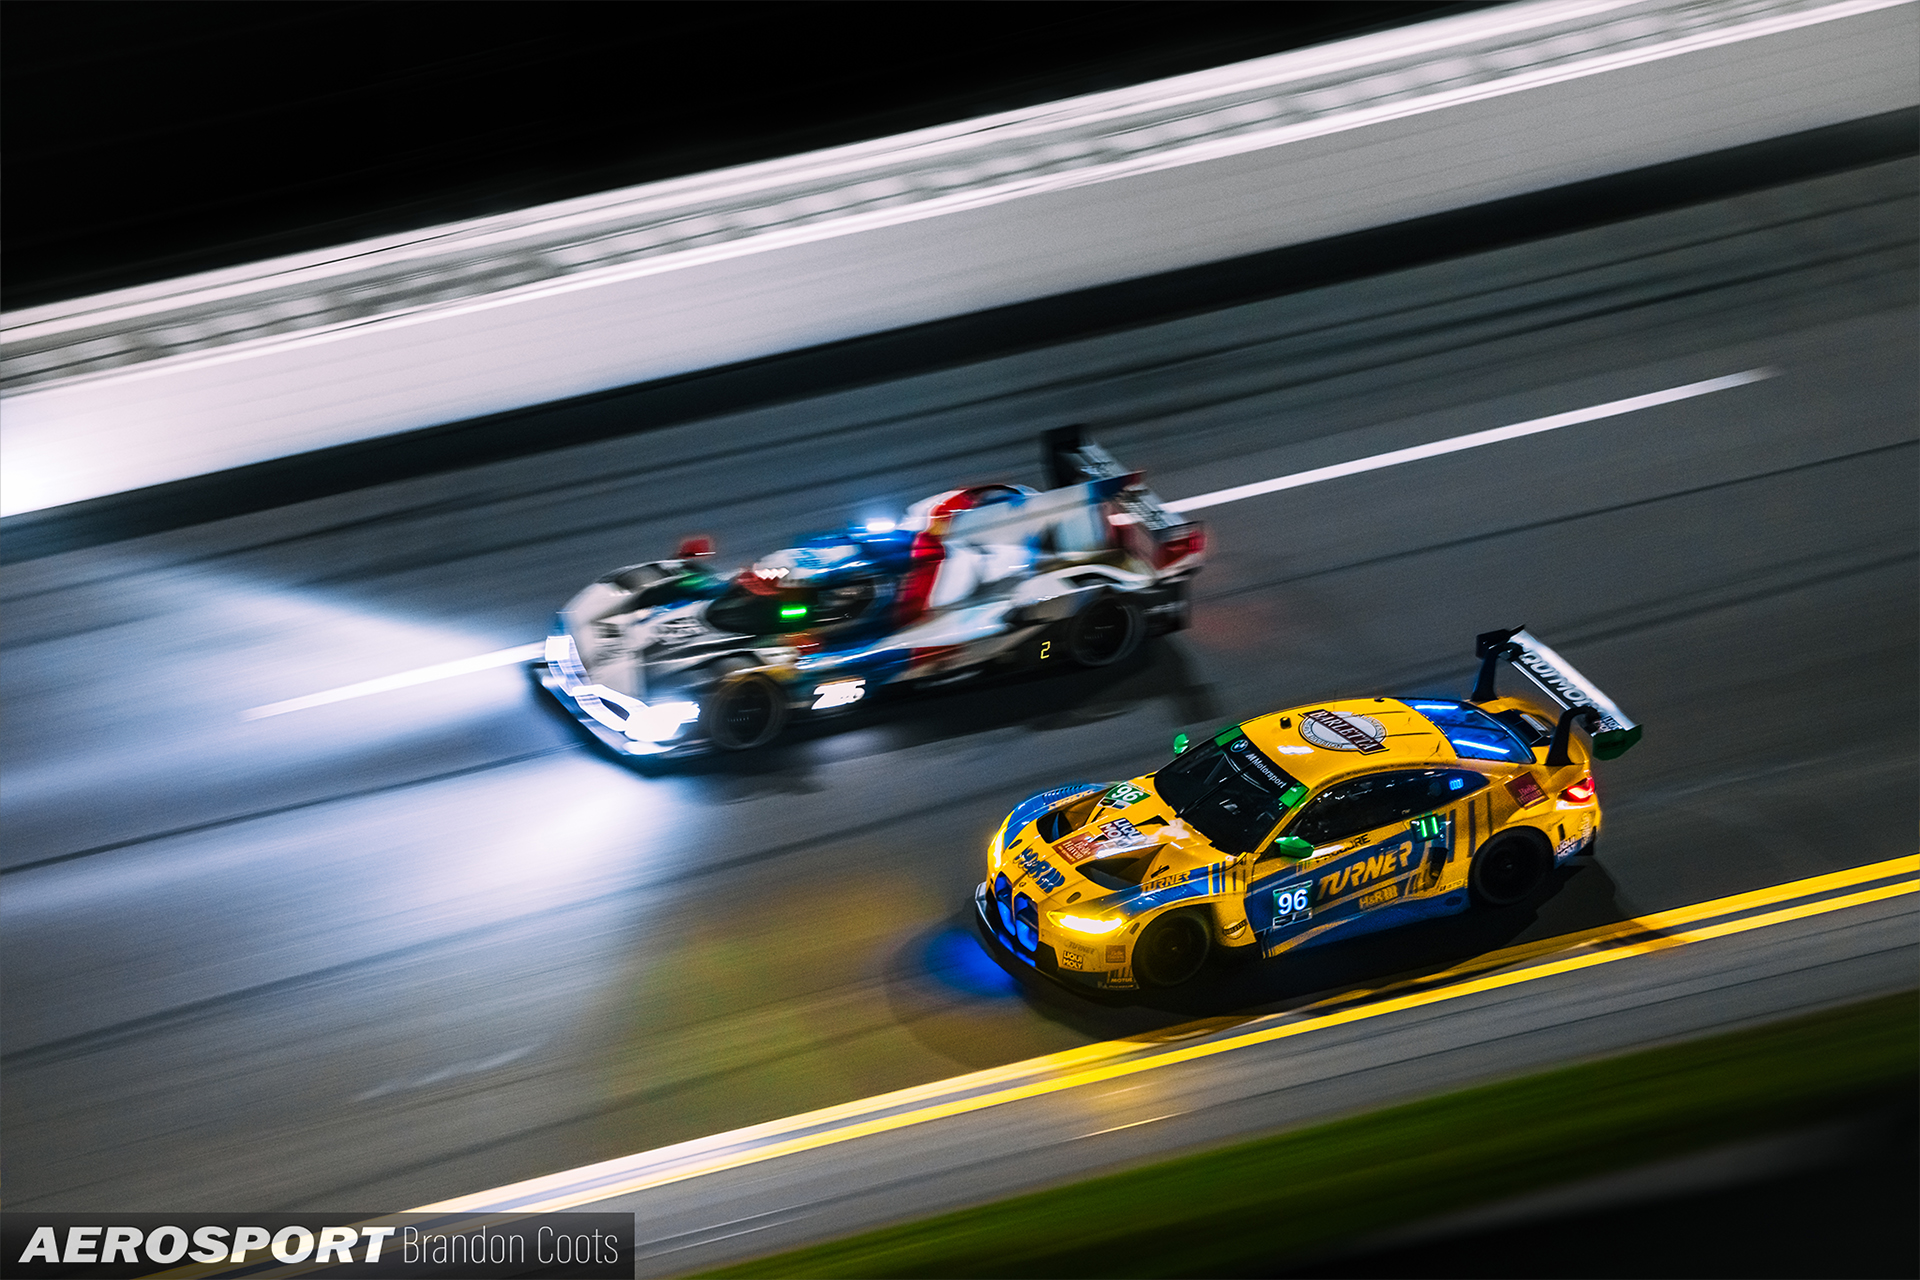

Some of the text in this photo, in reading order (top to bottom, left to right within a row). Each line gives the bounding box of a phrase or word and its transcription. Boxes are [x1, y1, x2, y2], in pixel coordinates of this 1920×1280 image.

[1040, 640, 1050, 660] 2
[1308, 711, 1379, 751] BARLETTA
[1251, 758, 1287, 789] Motorsport
[1111, 786, 1144, 801] 96
[1141, 870, 1191, 892] TURNER
[1317, 840, 1413, 900] TURNER
[1278, 888, 1308, 915] 96
[1063, 950, 1083, 963] LIQUI
[1063, 958, 1083, 970] MOLY
